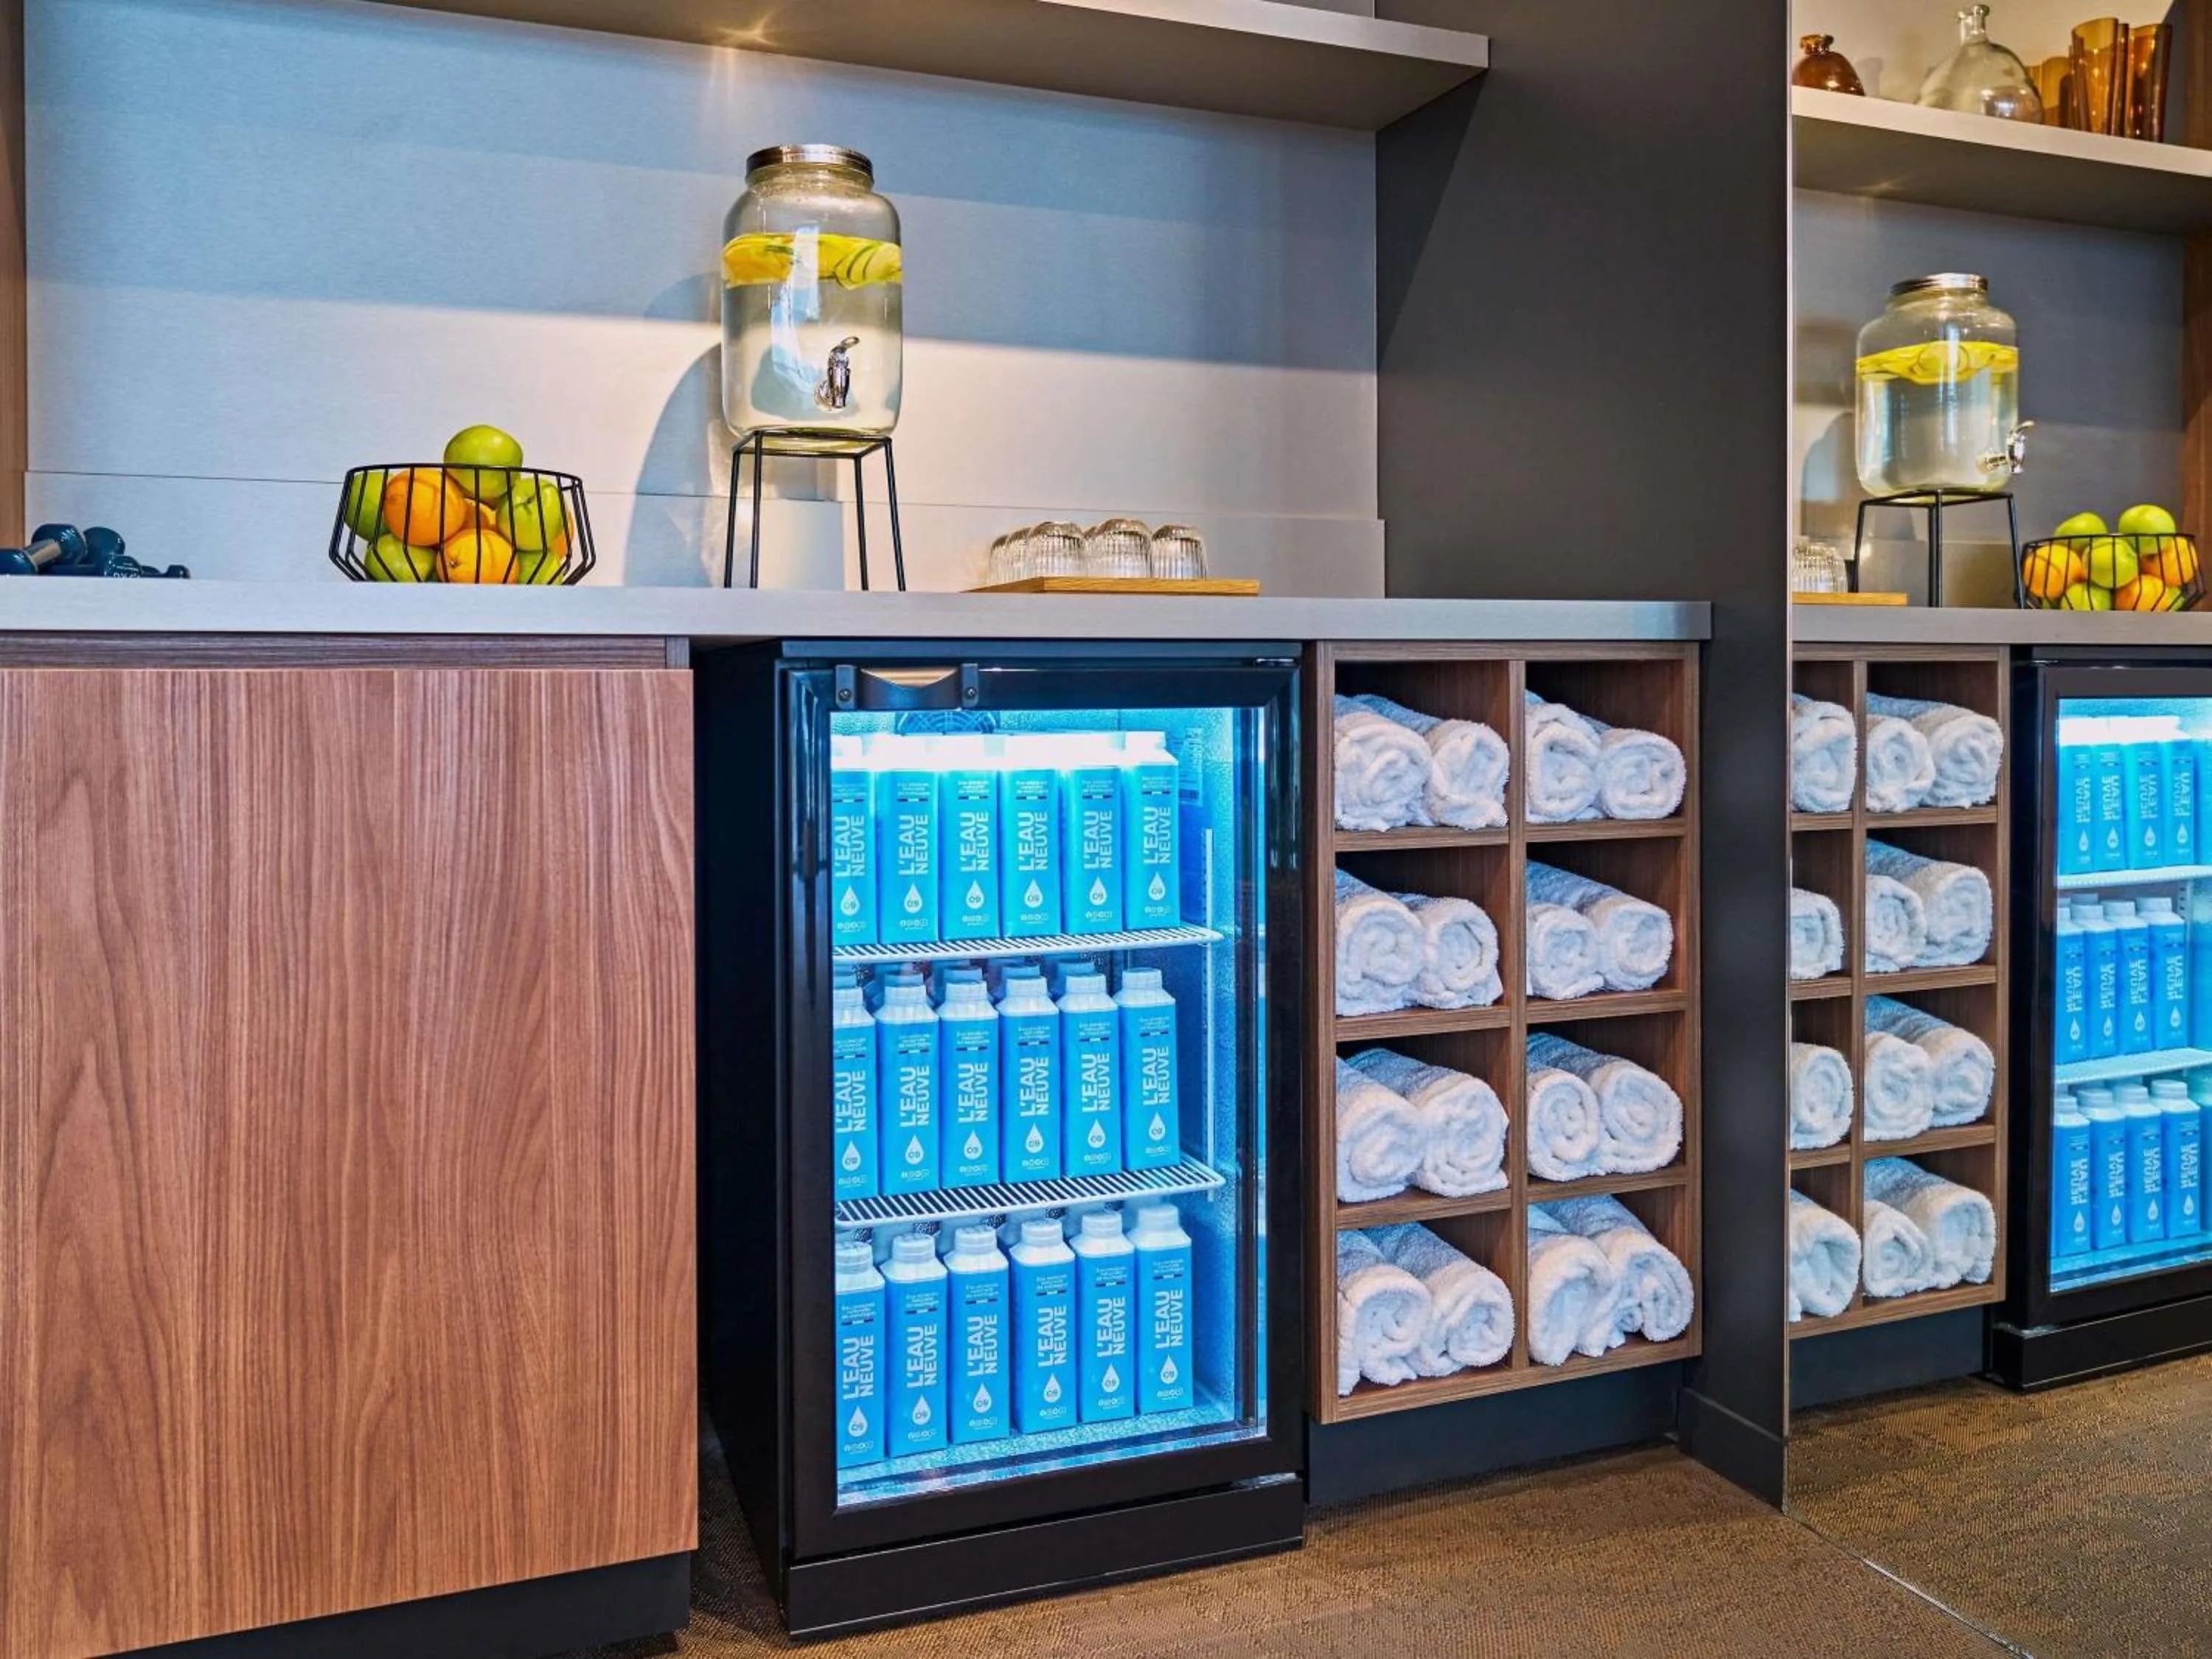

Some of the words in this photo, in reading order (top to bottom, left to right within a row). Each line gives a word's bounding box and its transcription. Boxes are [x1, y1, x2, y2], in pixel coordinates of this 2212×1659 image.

[834, 816, 850, 877] L'EAU
[850, 815, 865, 876] NEUVE
[899, 815, 914, 875] L'EAU
[914, 815, 928, 874] NEUVE
[960, 812, 976, 872] L'EAU
[976, 813, 989, 871] NEUVE
[1018, 812, 1034, 871] L'EAU
[1034, 813, 1048, 870] NEUVE
[1084, 811, 1099, 869] L'EAU
[1099, 811, 1112, 869] NEUVE
[1144, 807, 1158, 864] L'EAU
[1158, 807, 1171, 863] NEUVE
[835, 1072, 852, 1133] L'EAU
[852, 1071, 866, 1131] NEUVE
[900, 1067, 916, 1127] L'EAU
[916, 1065, 929, 1125] NEUVE
[959, 1063, 974, 1122] L'EAU
[974, 1063, 988, 1121] NEUVE
[1020, 1058, 1035, 1116] L'EAU
[1035, 1058, 1048, 1115] NEUVE
[1082, 1054, 1097, 1112] L'EAU
[1097, 1054, 1110, 1111] NEUVE
[1142, 1048, 1157, 1105] L'EAU
[1157, 1047, 1169, 1103] NEUVE
[967, 1317, 984, 1376] L'EAU
[984, 1315, 997, 1374] NEUVE
[1038, 1308, 1054, 1366] L'EAU
[1054, 1306, 1066, 1365] NEUVE
[1097, 1298, 1112, 1357] L'EAU
[1112, 1298, 1125, 1354] NEUVE
[1155, 1291, 1169, 1349] L'EAU
[1169, 1290, 1183, 1346] NEUVE
[843, 1338, 859, 1399] L'EAU
[859, 1336, 874, 1397] NEUVE
[907, 1326, 924, 1388] L'EAU
[924, 1325, 936, 1385] NEUVE
